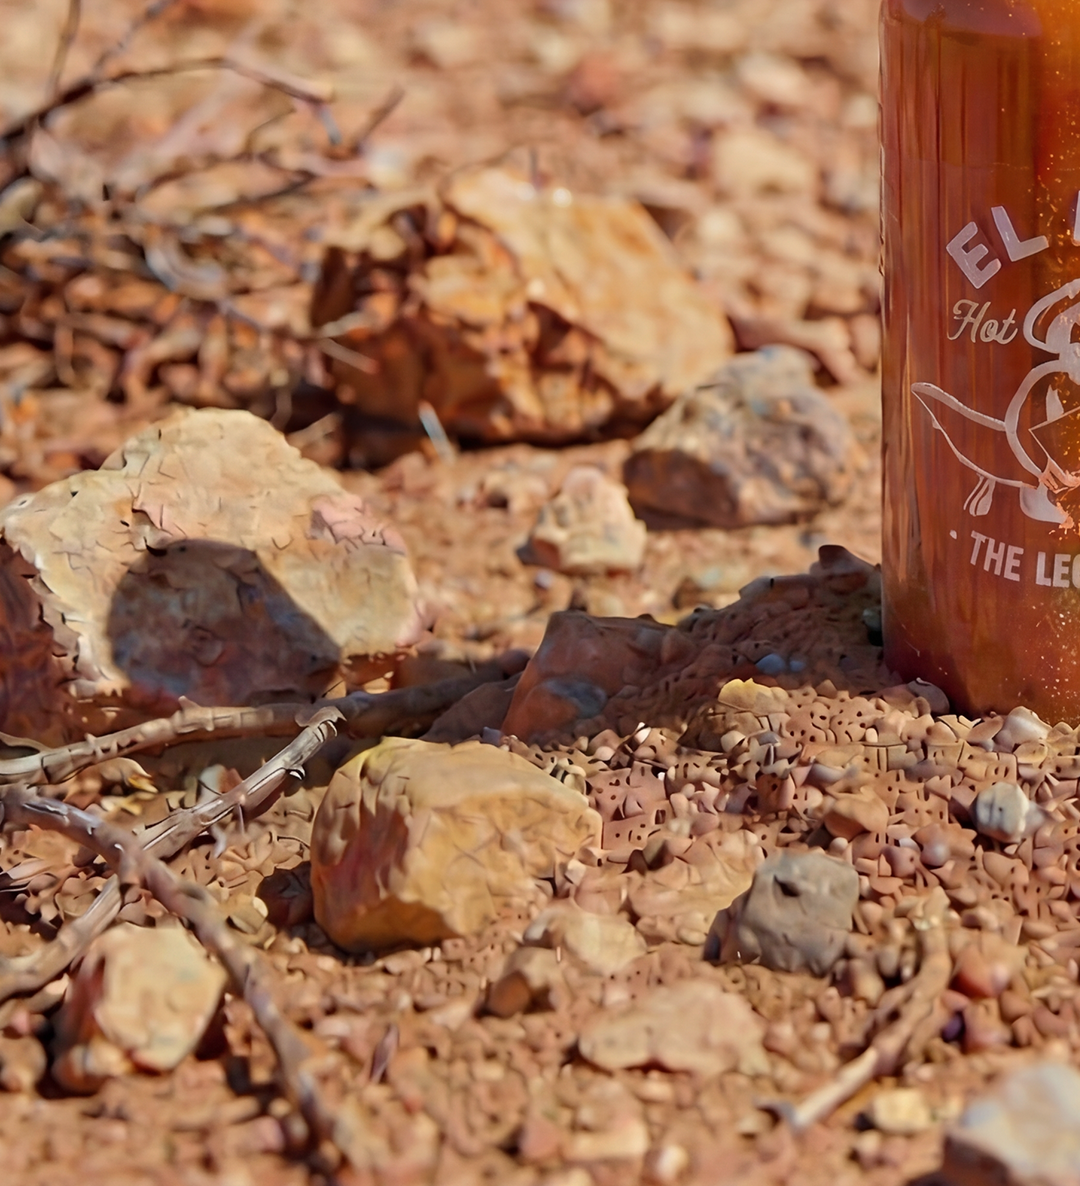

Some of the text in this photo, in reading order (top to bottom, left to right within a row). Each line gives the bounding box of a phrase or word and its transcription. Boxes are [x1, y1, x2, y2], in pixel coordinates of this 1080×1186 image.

[945, 205, 1050, 289] EL
[946, 299, 1019, 344] Hot
[969, 530, 1025, 582] THE
